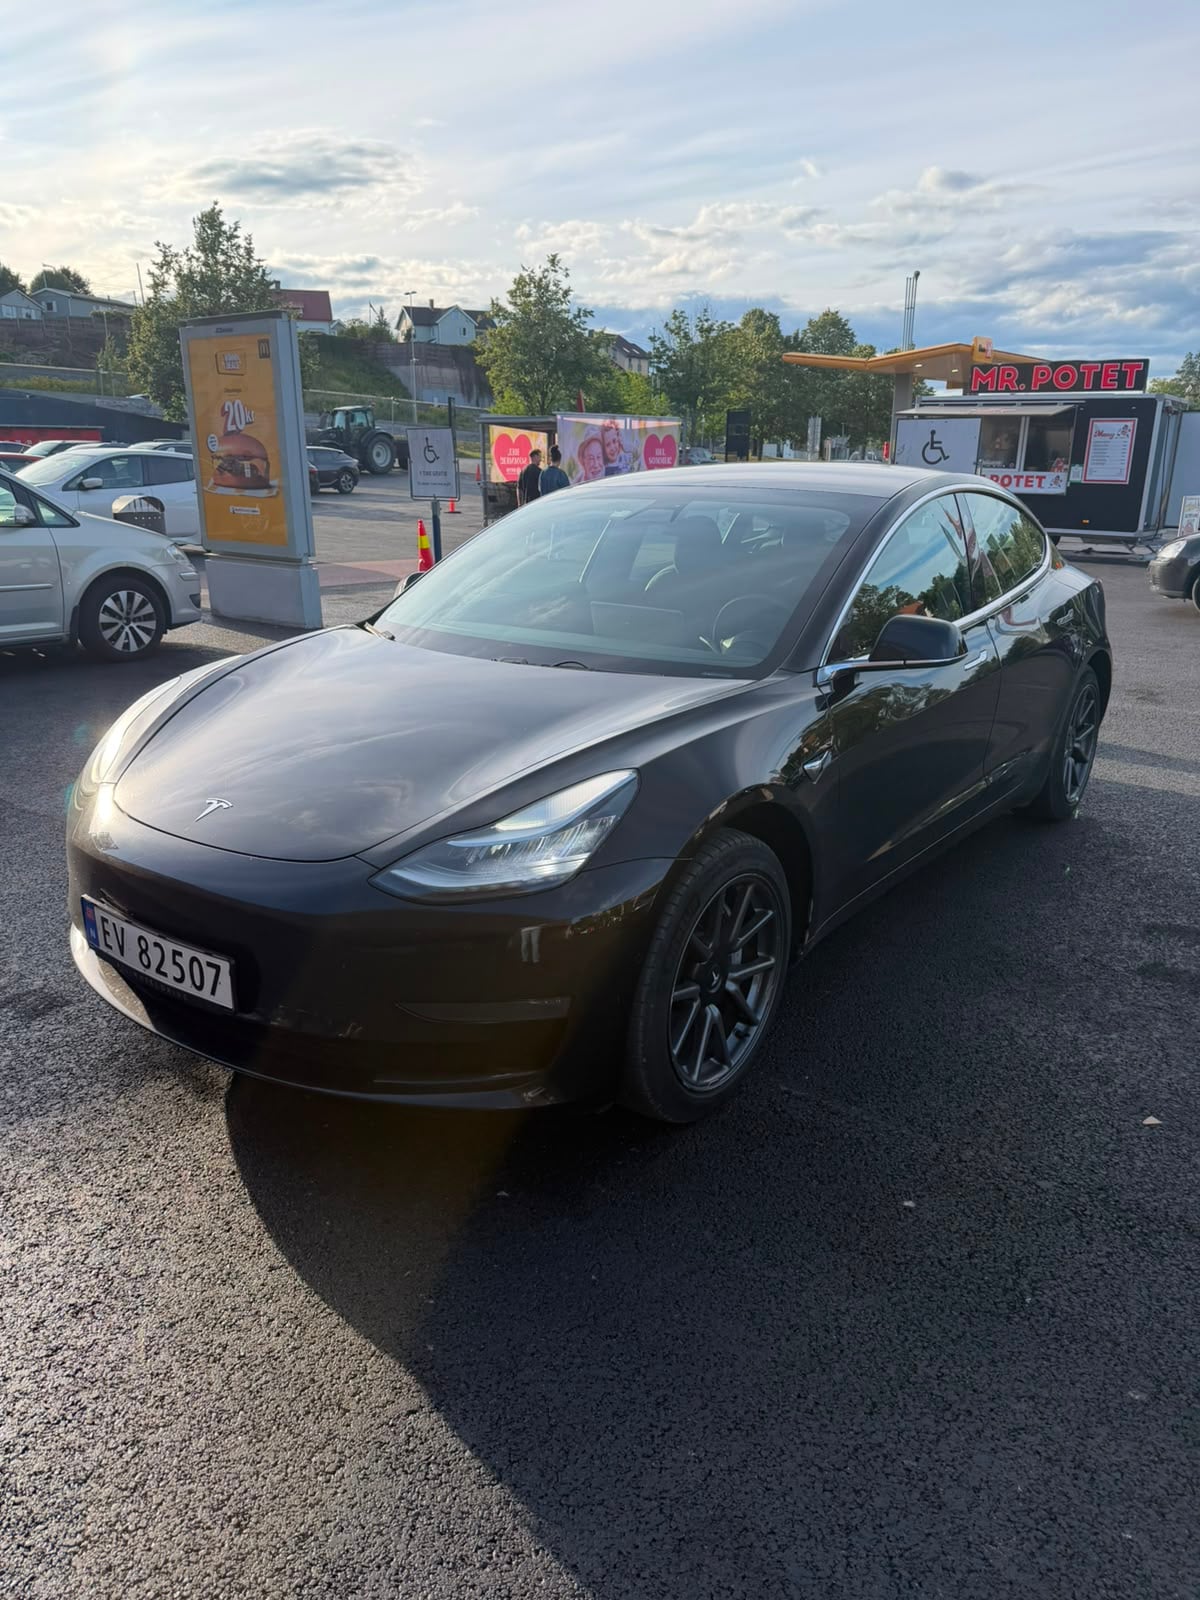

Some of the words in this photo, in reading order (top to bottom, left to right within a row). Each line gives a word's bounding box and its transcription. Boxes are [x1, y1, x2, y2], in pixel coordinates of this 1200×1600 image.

[971, 366, 1025, 391] MR.
[1031, 362, 1144, 391] POTET
[224, 399, 246, 431] 20
[989, 474, 1046, 488] POTET
[101, 915, 125, 957] EV
[137, 934, 222, 997] 82507
